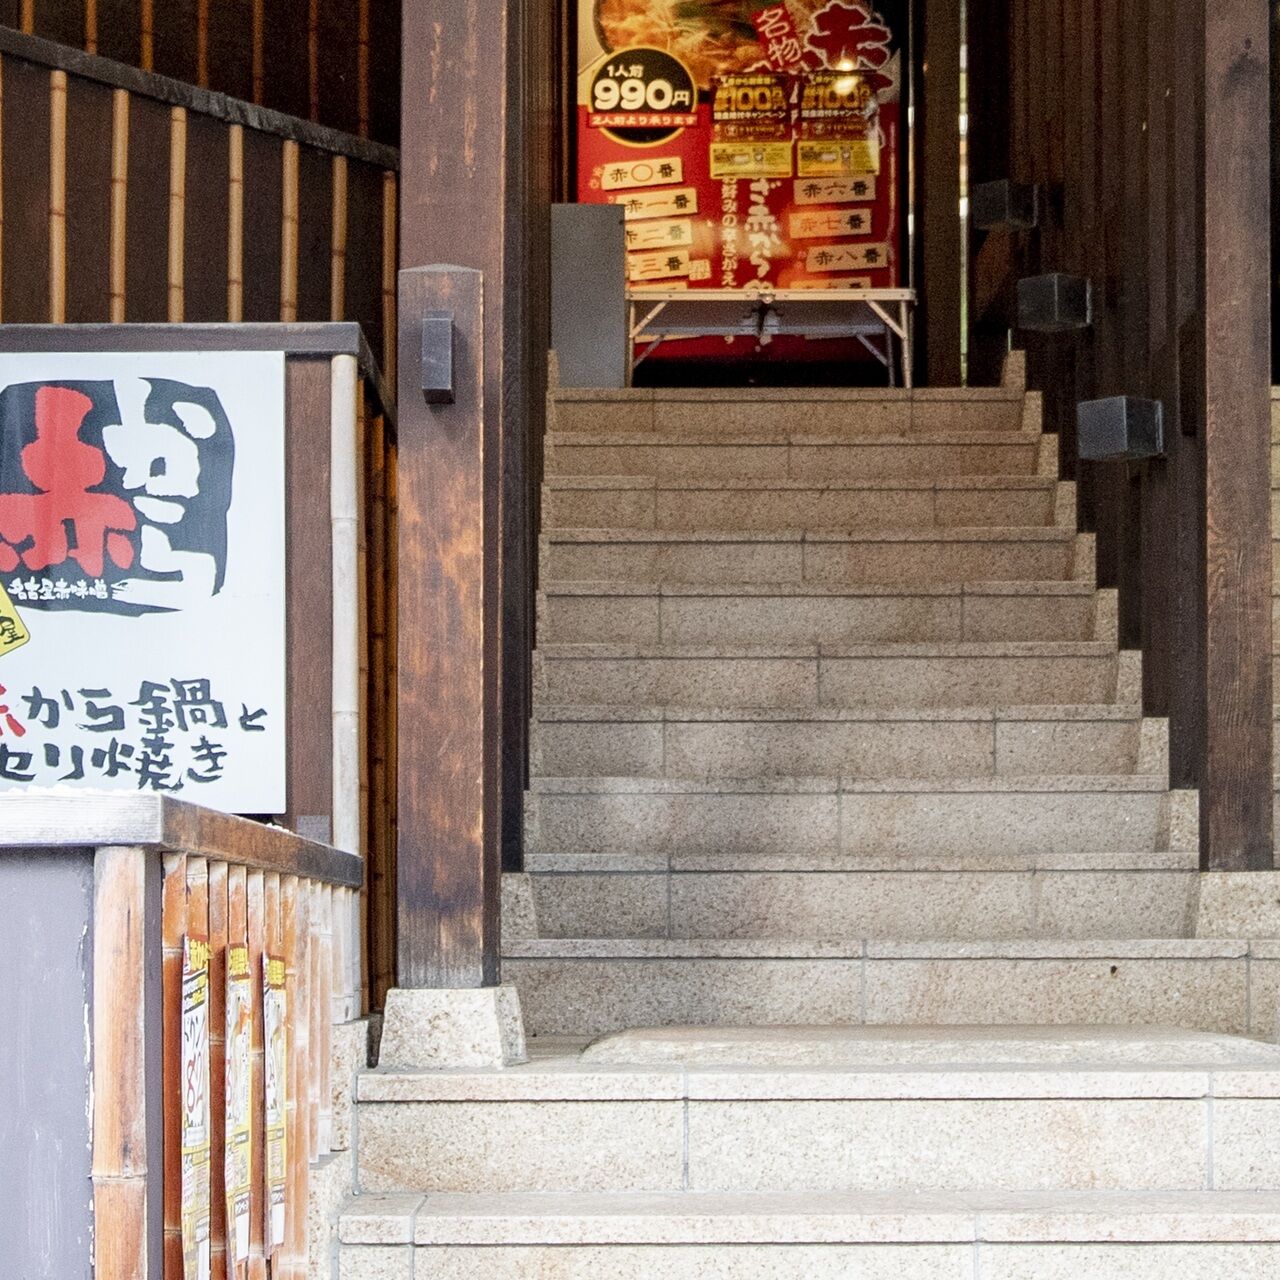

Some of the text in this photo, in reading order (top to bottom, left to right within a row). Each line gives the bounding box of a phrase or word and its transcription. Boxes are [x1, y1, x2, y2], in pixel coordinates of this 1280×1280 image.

[756, 7, 802, 67] 名物
[607, 64, 644, 78] 1人前
[594, 78, 690, 111] 990円
[802, 180, 870, 199] 赤六番
[721, 178, 738, 290] 好みの辛さがえ
[629, 255, 684, 274] 三番
[814, 247, 881, 266] 赤八番
